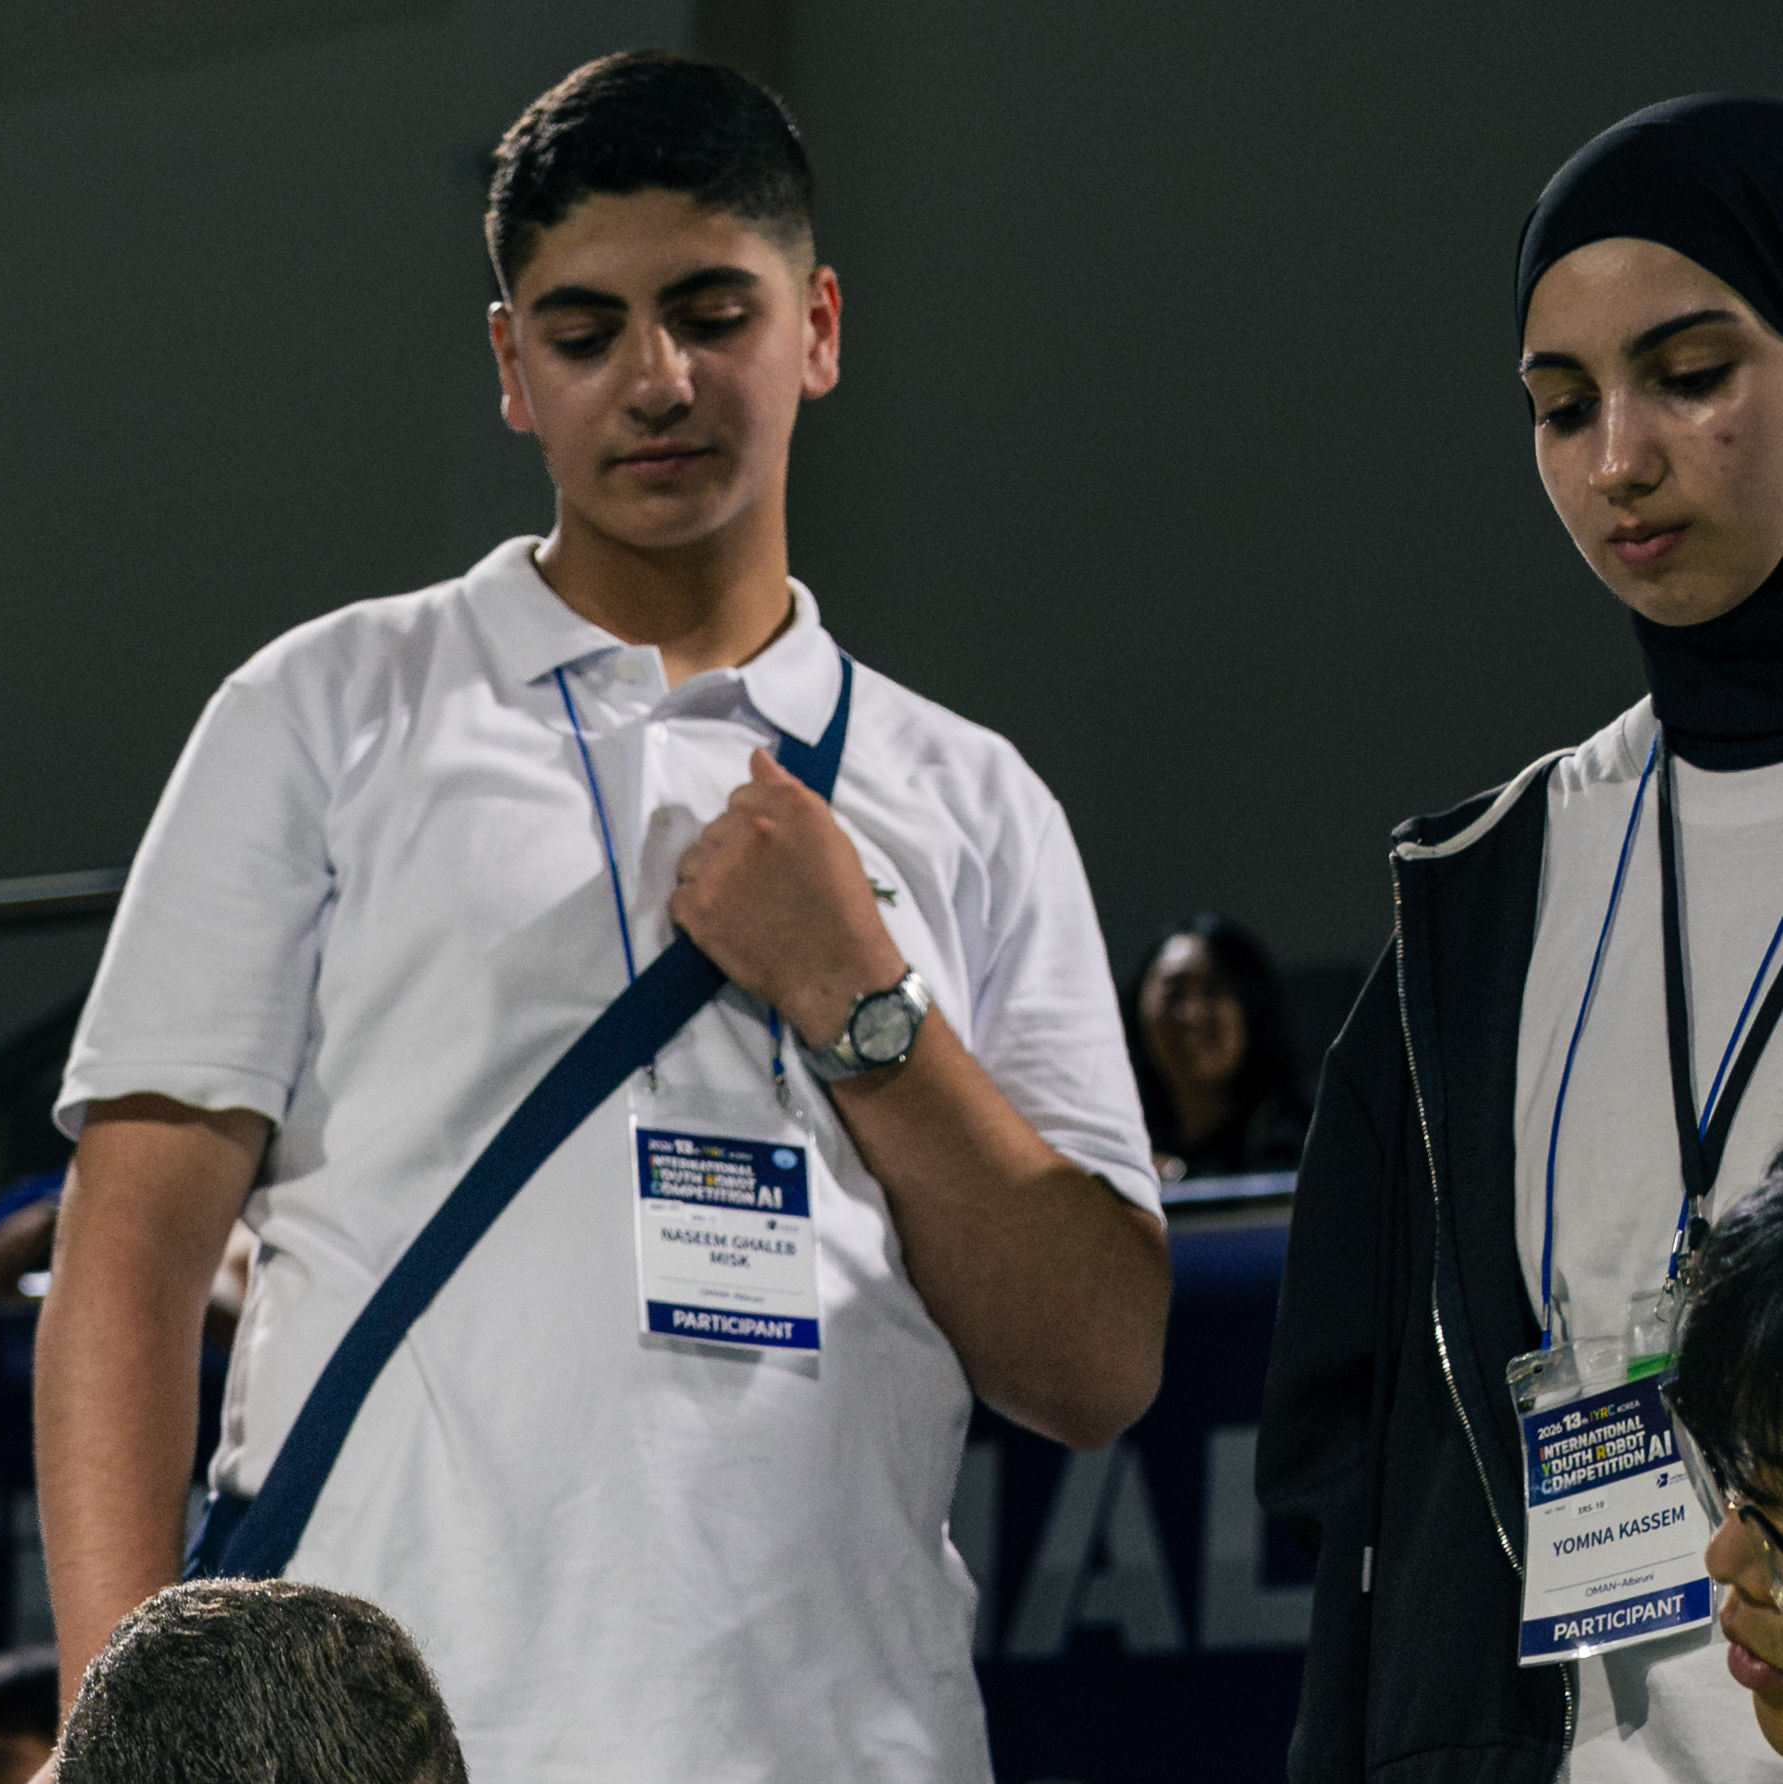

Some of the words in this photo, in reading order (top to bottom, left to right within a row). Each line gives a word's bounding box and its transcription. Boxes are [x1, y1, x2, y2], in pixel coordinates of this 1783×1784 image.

[757, 1185, 783, 1210] AI
[661, 1227, 727, 1248] NASEEM
[710, 1250, 750, 1268] MISK
[673, 1308, 795, 1340] PARTICIPANT
[1537, 1422, 1563, 1440] 2026
[1590, 1403, 1616, 1422] IYRC
[1539, 1415, 1645, 1462] INTERNATIONAL
[1541, 1449, 1594, 1477] YOUTH
[1595, 1431, 1646, 1461] ROBOT
[1541, 1448, 1646, 1495] COMPETITION
[1648, 1430, 1673, 1463] AI
[1553, 1526, 1614, 1557] YOMNA
[1619, 1504, 1686, 1540] KASSEM
[1553, 1594, 1685, 1642] PARTICIPANT
